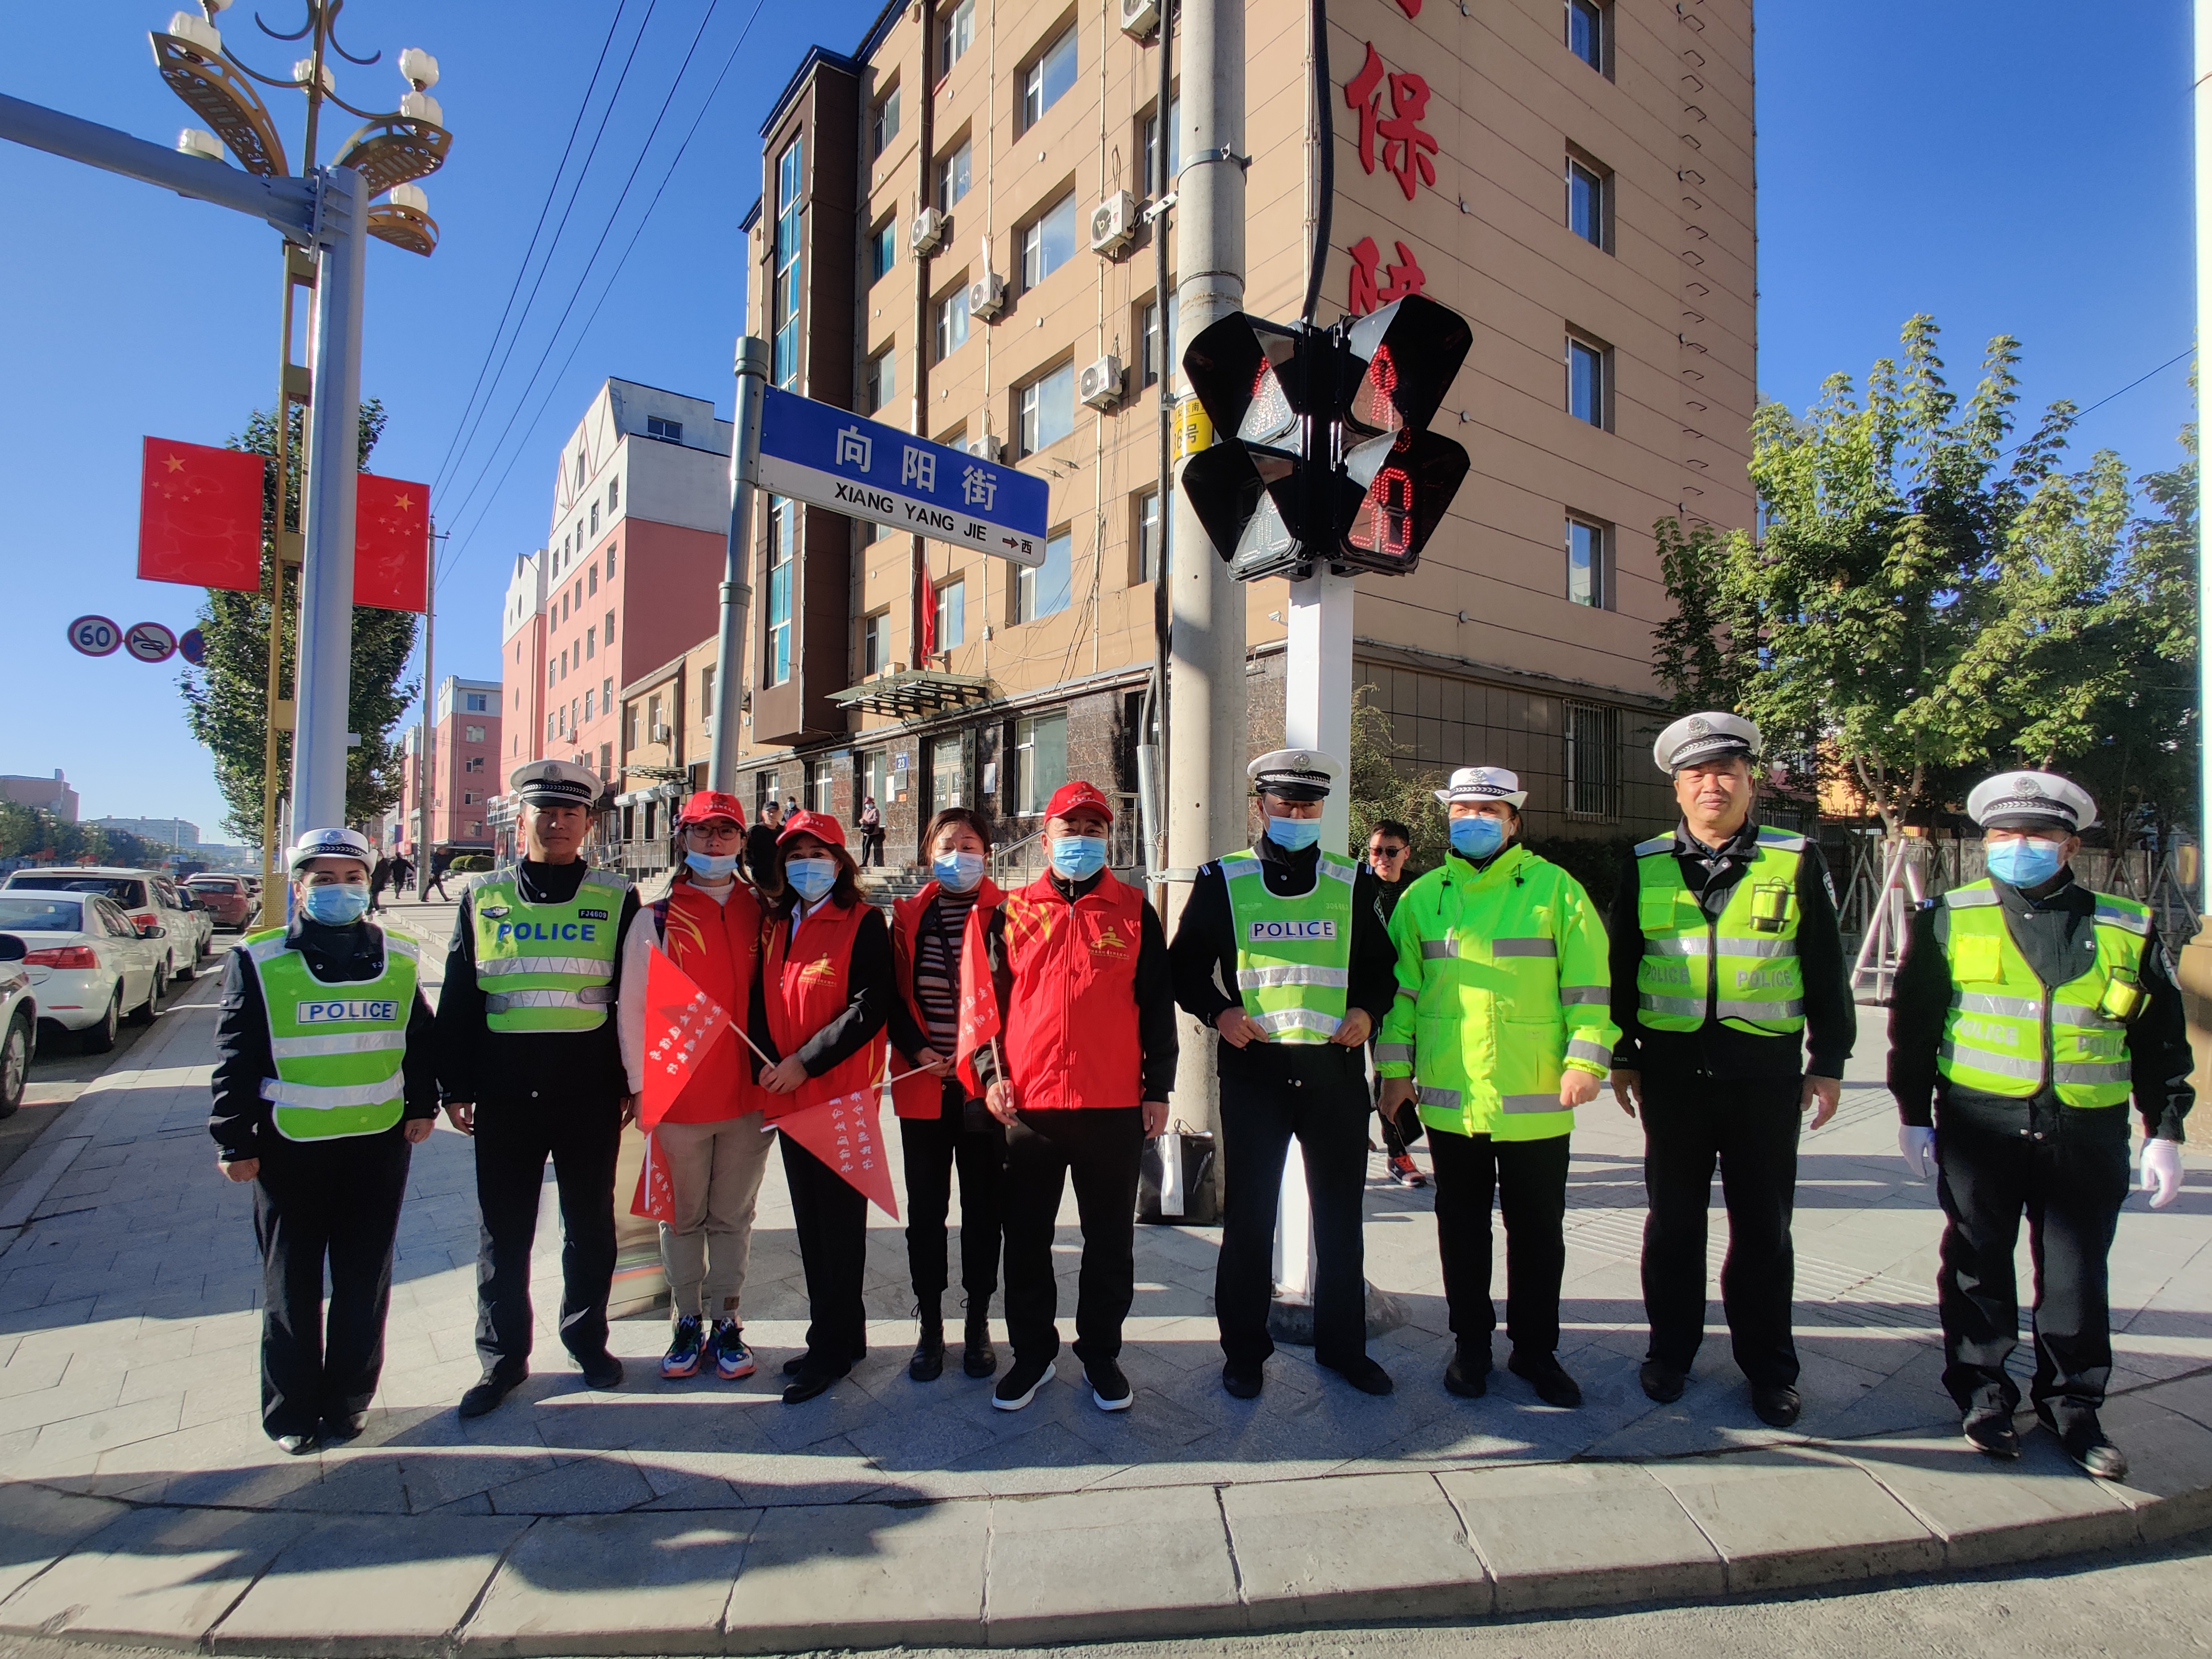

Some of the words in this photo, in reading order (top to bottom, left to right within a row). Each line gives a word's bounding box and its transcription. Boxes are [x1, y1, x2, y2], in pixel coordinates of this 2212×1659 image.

[835, 425, 998, 512] 向阳街
[835, 482, 894, 514] XIANG
[904, 503, 954, 531] YANG
[963, 522, 987, 542] JIE
[1021, 539, 1033, 555] 西
[80, 625, 110, 647] 60
[898, 758, 905, 769] 23
[581, 910, 607, 919] FJ4609
[498, 923, 595, 941] POLICE
[1254, 921, 1333, 937] POLICE
[1736, 969, 1793, 988] POLICE
[310, 1003, 392, 1020] POLICE
